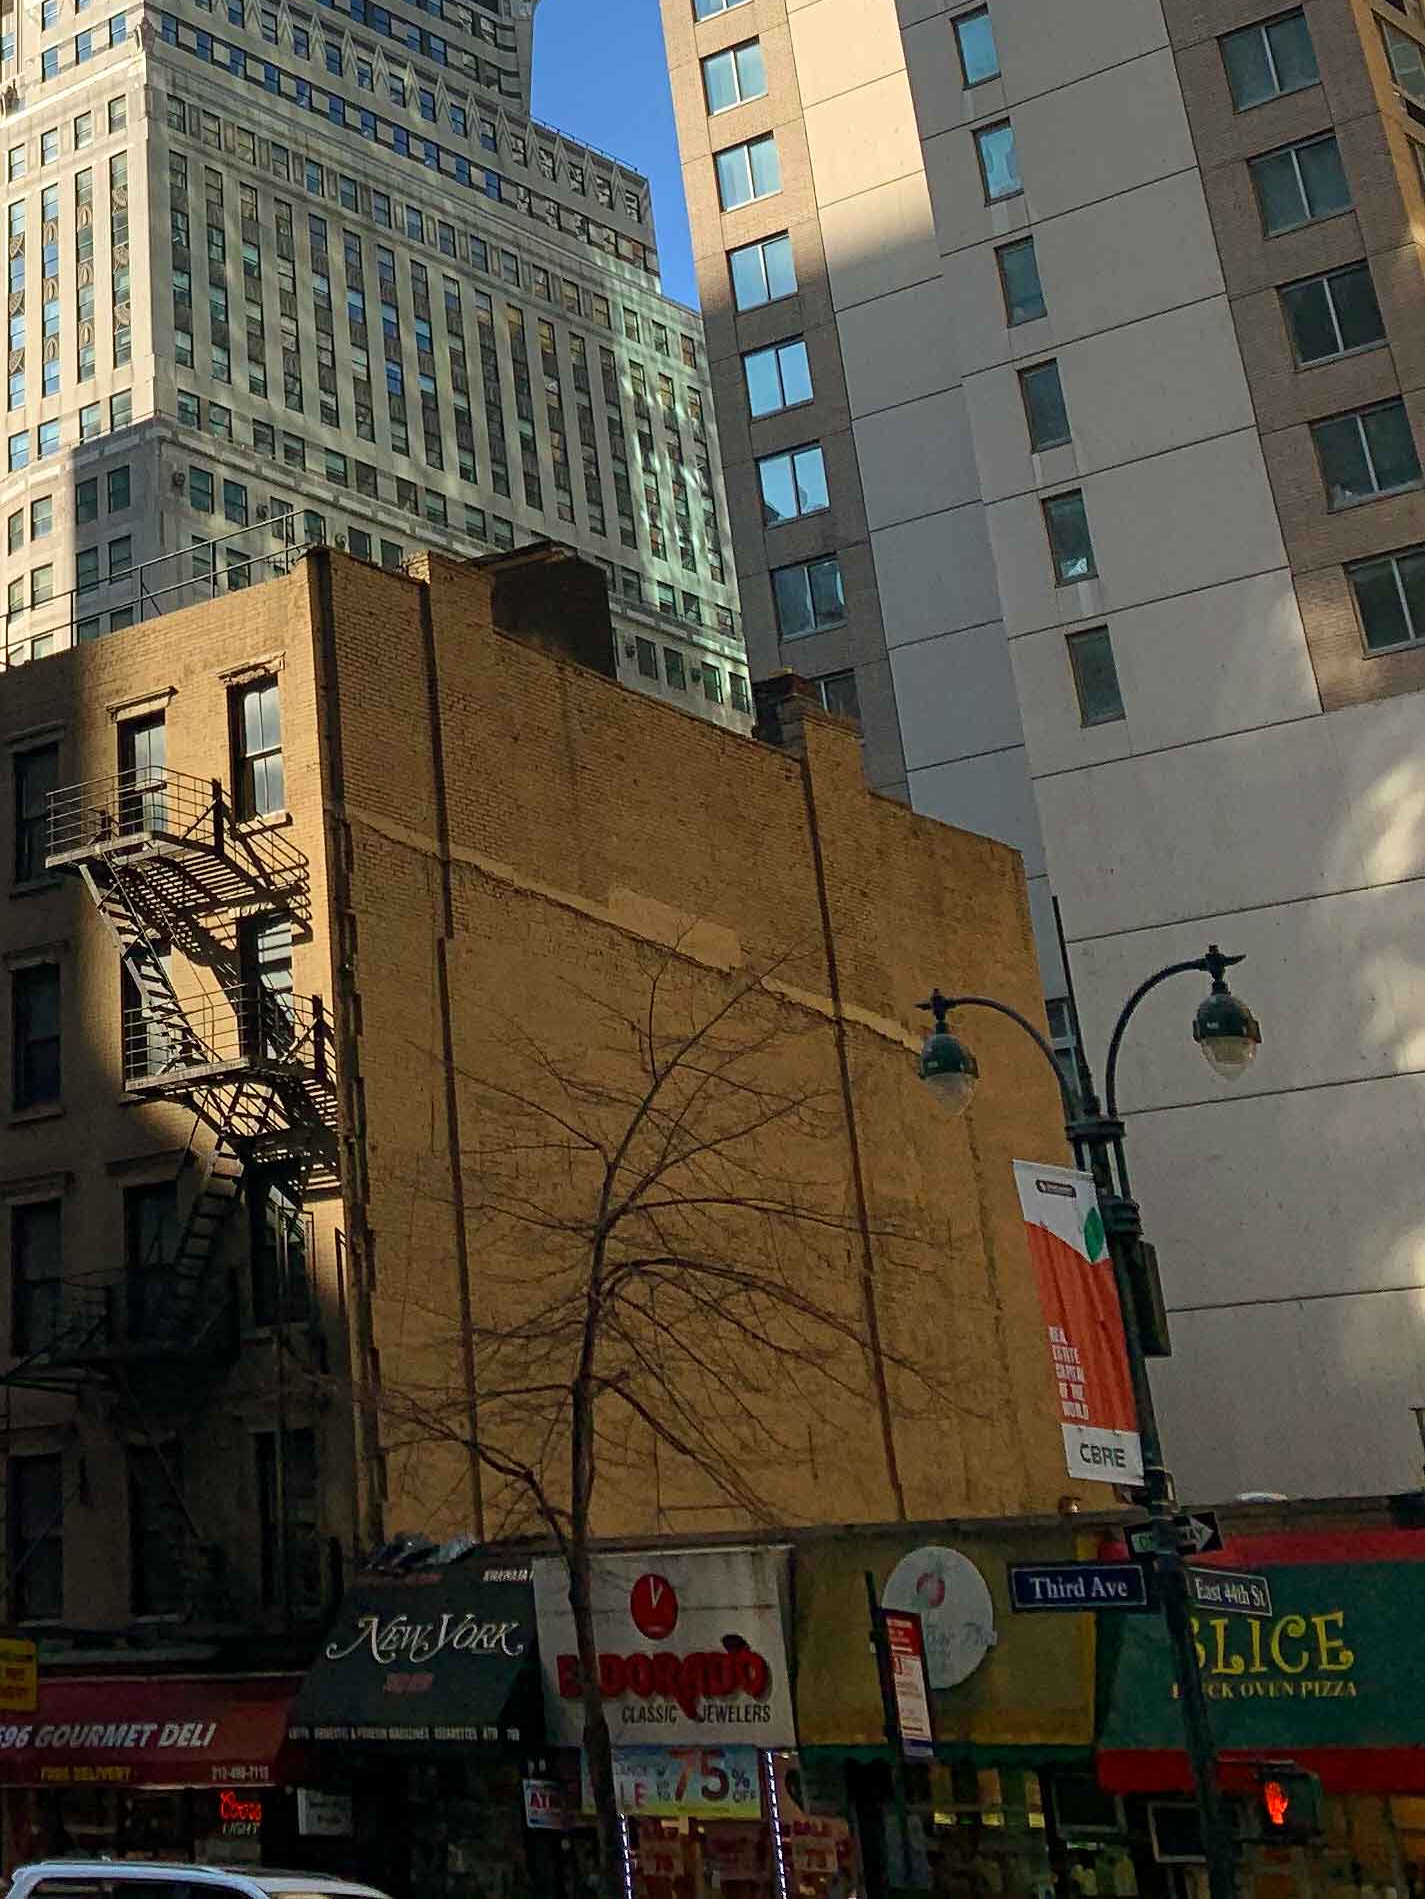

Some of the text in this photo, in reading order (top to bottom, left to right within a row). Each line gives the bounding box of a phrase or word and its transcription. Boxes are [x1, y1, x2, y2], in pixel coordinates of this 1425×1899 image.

[1080, 1442, 1126, 1468] CBRE
[1029, 1575, 1129, 1600] Third Ave
[1194, 1577, 1221, 1601] East
[1251, 1584, 1266, 1607] St
[557, 1650, 768, 1713] EDORADO
[1240, 1680, 1293, 1700] OVEN
[1300, 1679, 1358, 1700] PIZZA
[622, 1702, 770, 1724] CLASSIC JEWELERS
[33, 1723, 159, 1750] GOURMET
[158, 1721, 218, 1749] DELI
[670, 1748, 730, 1801] 75
